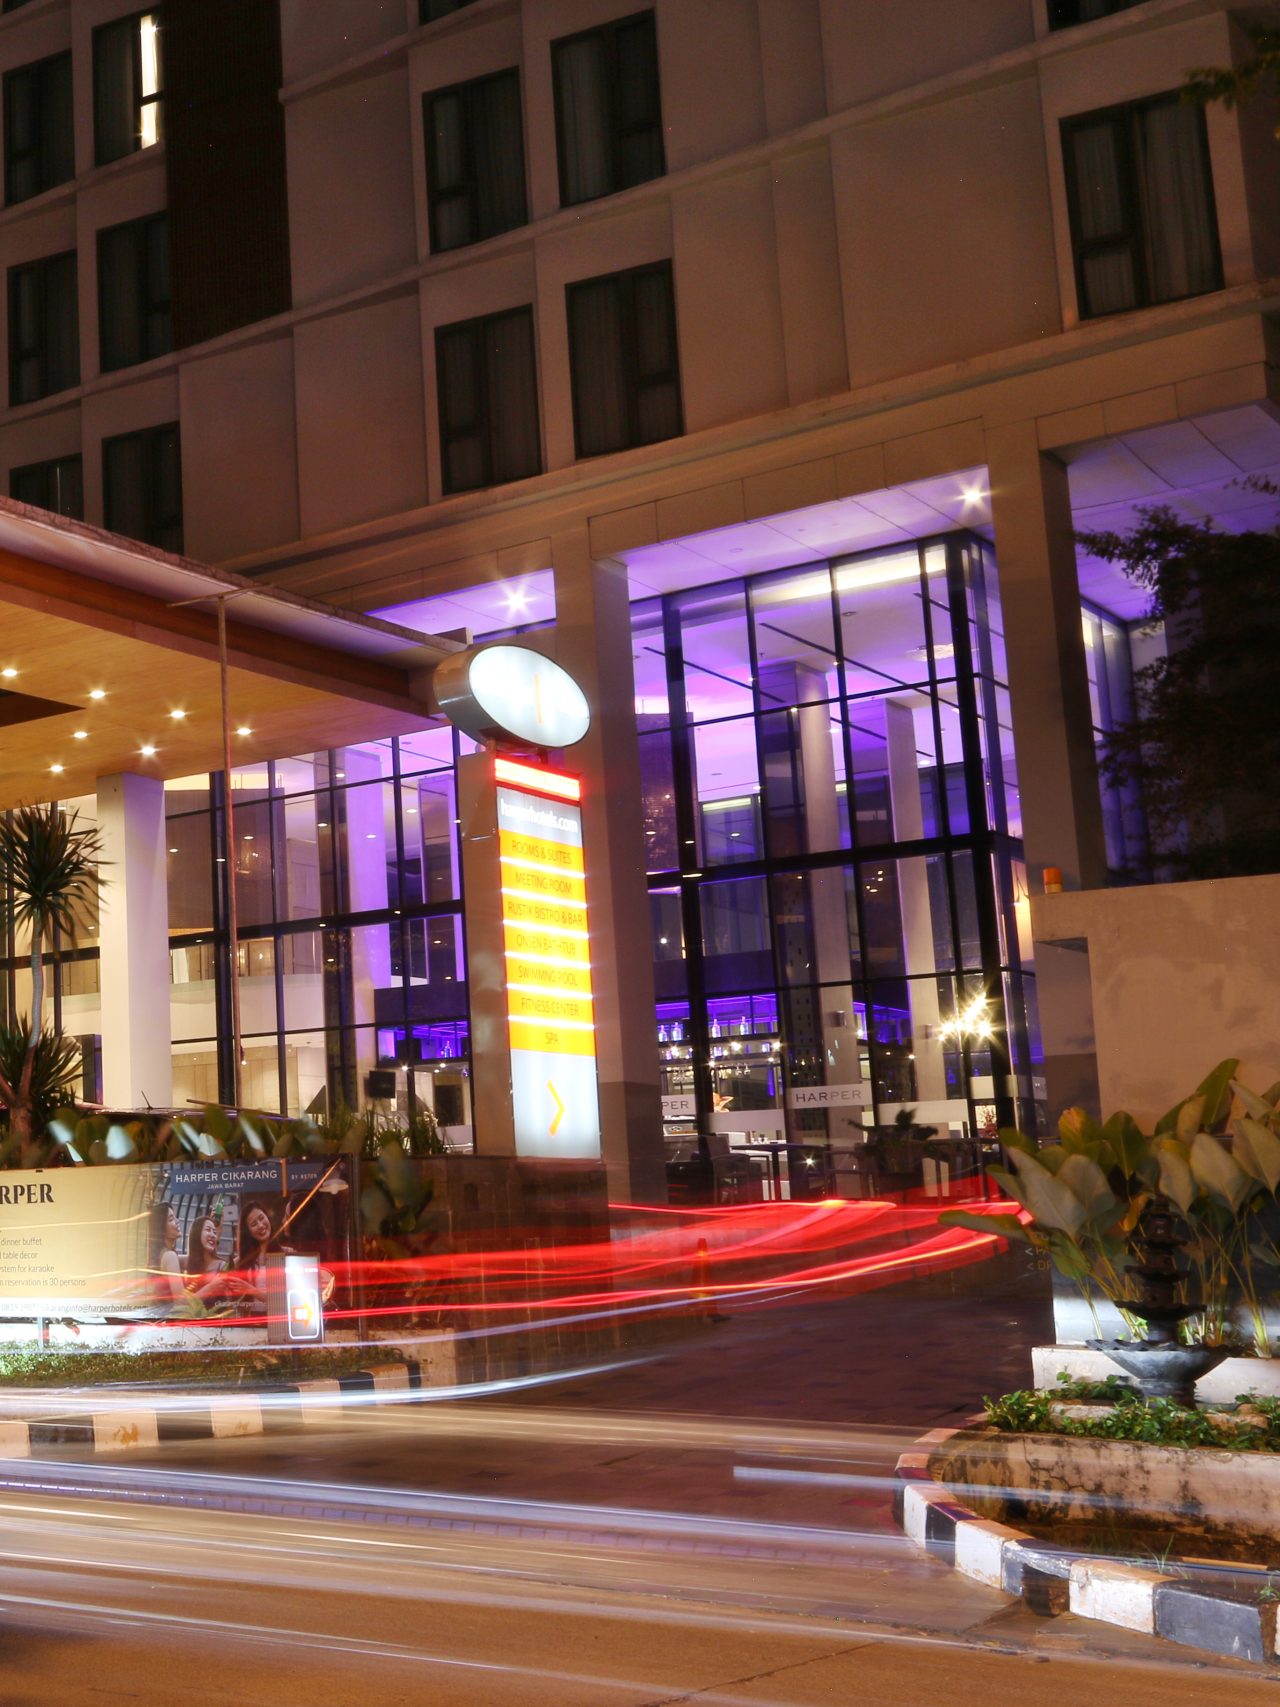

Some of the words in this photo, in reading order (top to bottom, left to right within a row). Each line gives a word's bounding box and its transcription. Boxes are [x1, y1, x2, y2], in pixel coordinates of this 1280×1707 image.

[511, 840, 539, 858] ROOMS
[548, 849, 572, 865] SUITES
[515, 872, 549, 888] MEETING
[549, 878, 573, 895] ROOM
[508, 901, 533, 917] RUSTIK
[534, 904, 560, 922] BISTRO
[567, 912, 583, 926] BAR
[557, 971, 579, 986] POOL
[521, 998, 550, 1014] FITNESS
[551, 1001, 580, 1017] CENTER
[545, 1032, 559, 1045] SPA
[795, 1089, 862, 1104] HARPER
[175, 1172, 219, 1184] HARPER
[221, 1170, 278, 1182] CIKARANG
[0, 1238, 21, 1246] dinner
[22, 1237, 42, 1246] buffet
[2, 1251, 19, 1260] table
[19, 1250, 39, 1259] decor
[17, 1264, 27, 1273] for
[28, 1264, 55, 1273] karaoke
[5, 1278, 41, 1287] reservation
[49, 1277, 59, 1286] 30
[60, 1278, 86, 1288] persons
